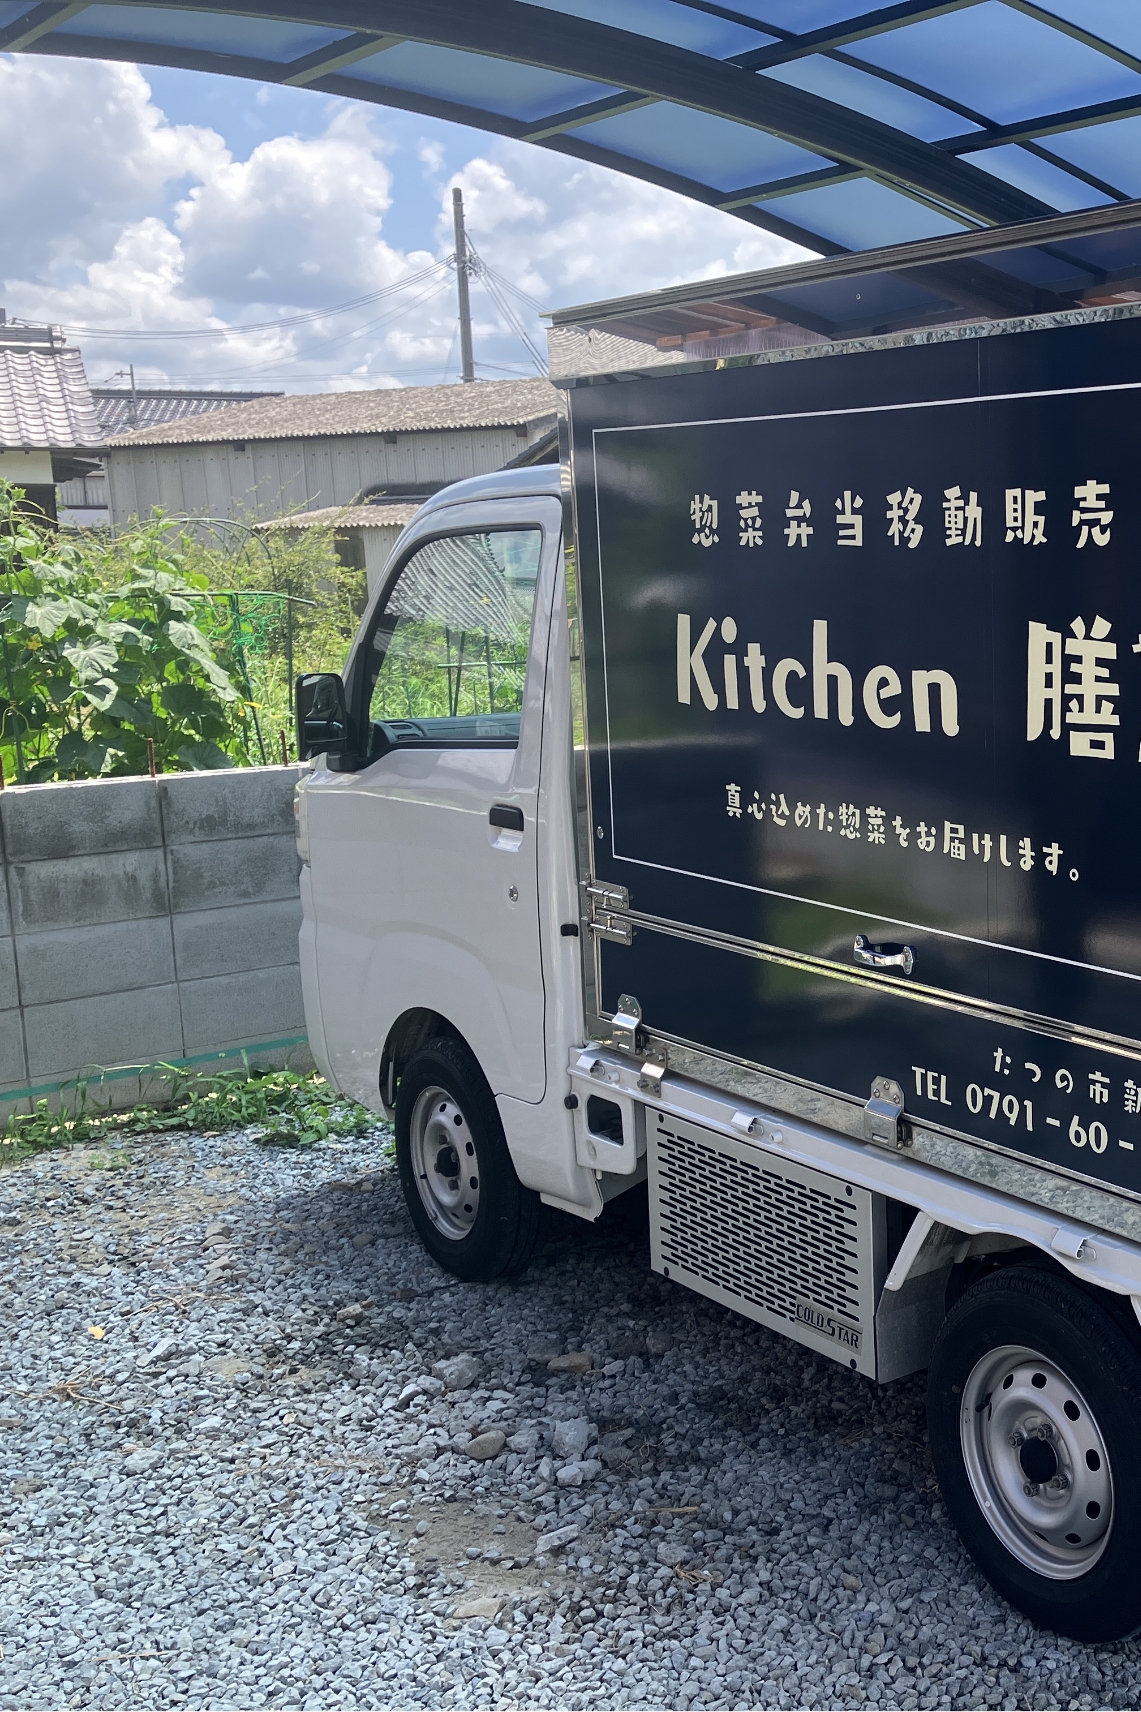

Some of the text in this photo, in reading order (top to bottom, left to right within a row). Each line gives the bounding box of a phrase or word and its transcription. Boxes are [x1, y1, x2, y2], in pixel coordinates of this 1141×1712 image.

[690, 480, 1114, 549] 惣菜弁当移動販売
[676, 613, 1121, 760] Kitchen 膳
[725, 783, 1079, 882] 真心込めた惣菜をお届けします。
[911, 1065, 952, 1106] TEL
[796, 1303, 861, 1349] COLD STAR
